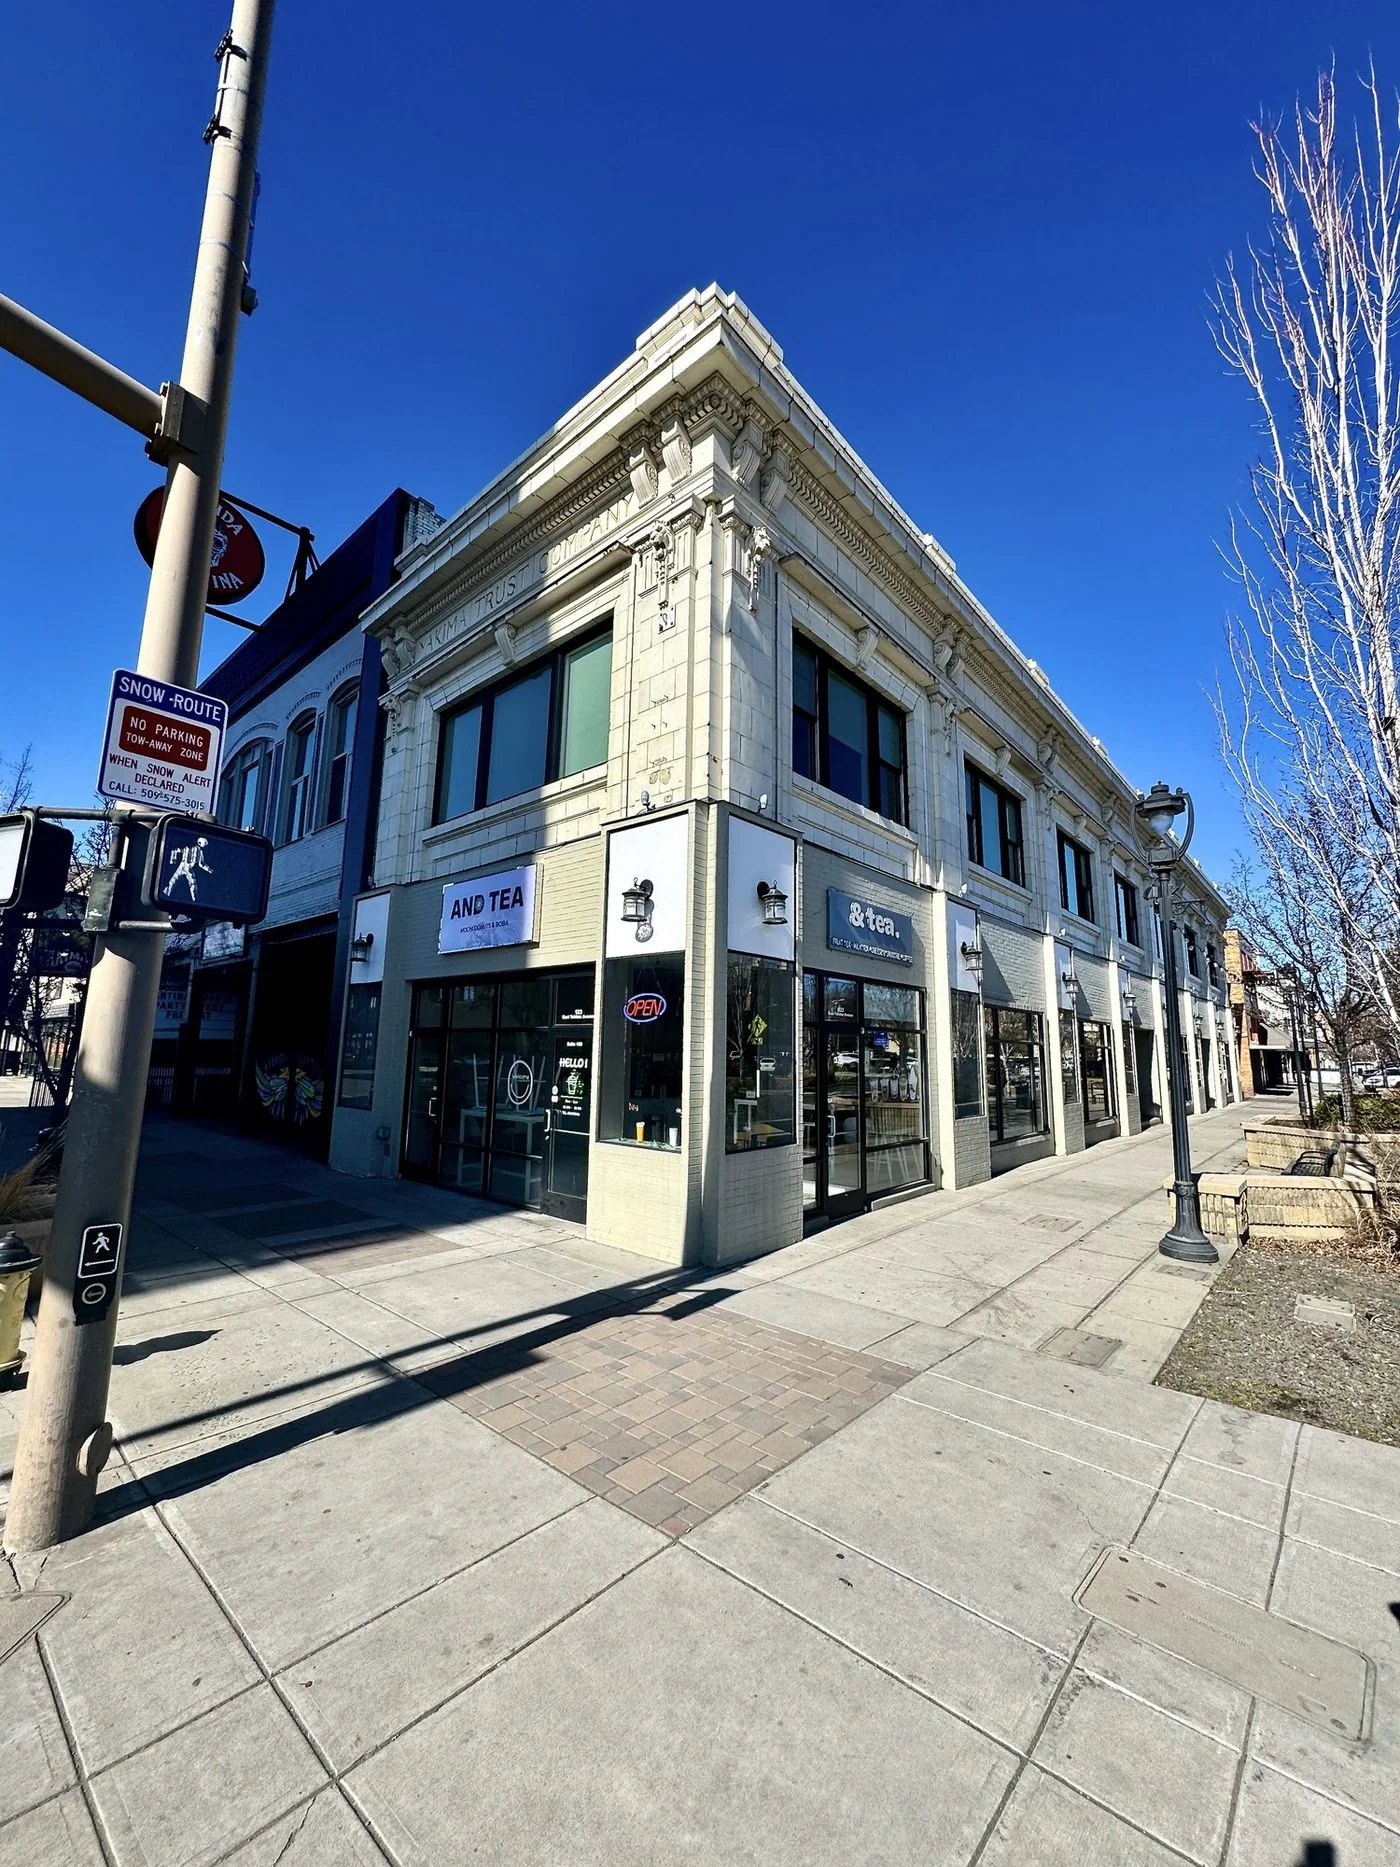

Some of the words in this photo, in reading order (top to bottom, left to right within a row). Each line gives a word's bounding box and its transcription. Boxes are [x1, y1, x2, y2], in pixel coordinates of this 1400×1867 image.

[475, 563, 530, 619] TRUST
[538, 492, 636, 574] COMPANY
[211, 572, 244, 589] INA
[119, 676, 165, 703] SNOW
[173, 693, 222, 721] ROUTE
[126, 732, 173, 753] TOW-AWAY
[180, 747, 204, 762] ZONE
[130, 716, 146, 731] NO
[155, 724, 204, 747] PARKING
[109, 753, 138, 770] WHEN
[146, 764, 175, 779] SNOW
[182, 773, 211, 788] ALERT
[134, 773, 185, 794] DECLARED
[108, 780, 137, 795] CALL:
[141, 788, 205, 811] 509-575-3015
[450, 894, 485, 920] AND
[489, 885, 524, 912] TEA
[849, 902, 864, 928] &
[865, 907, 900, 939] tea.
[626, 999, 662, 1017] OPEN
